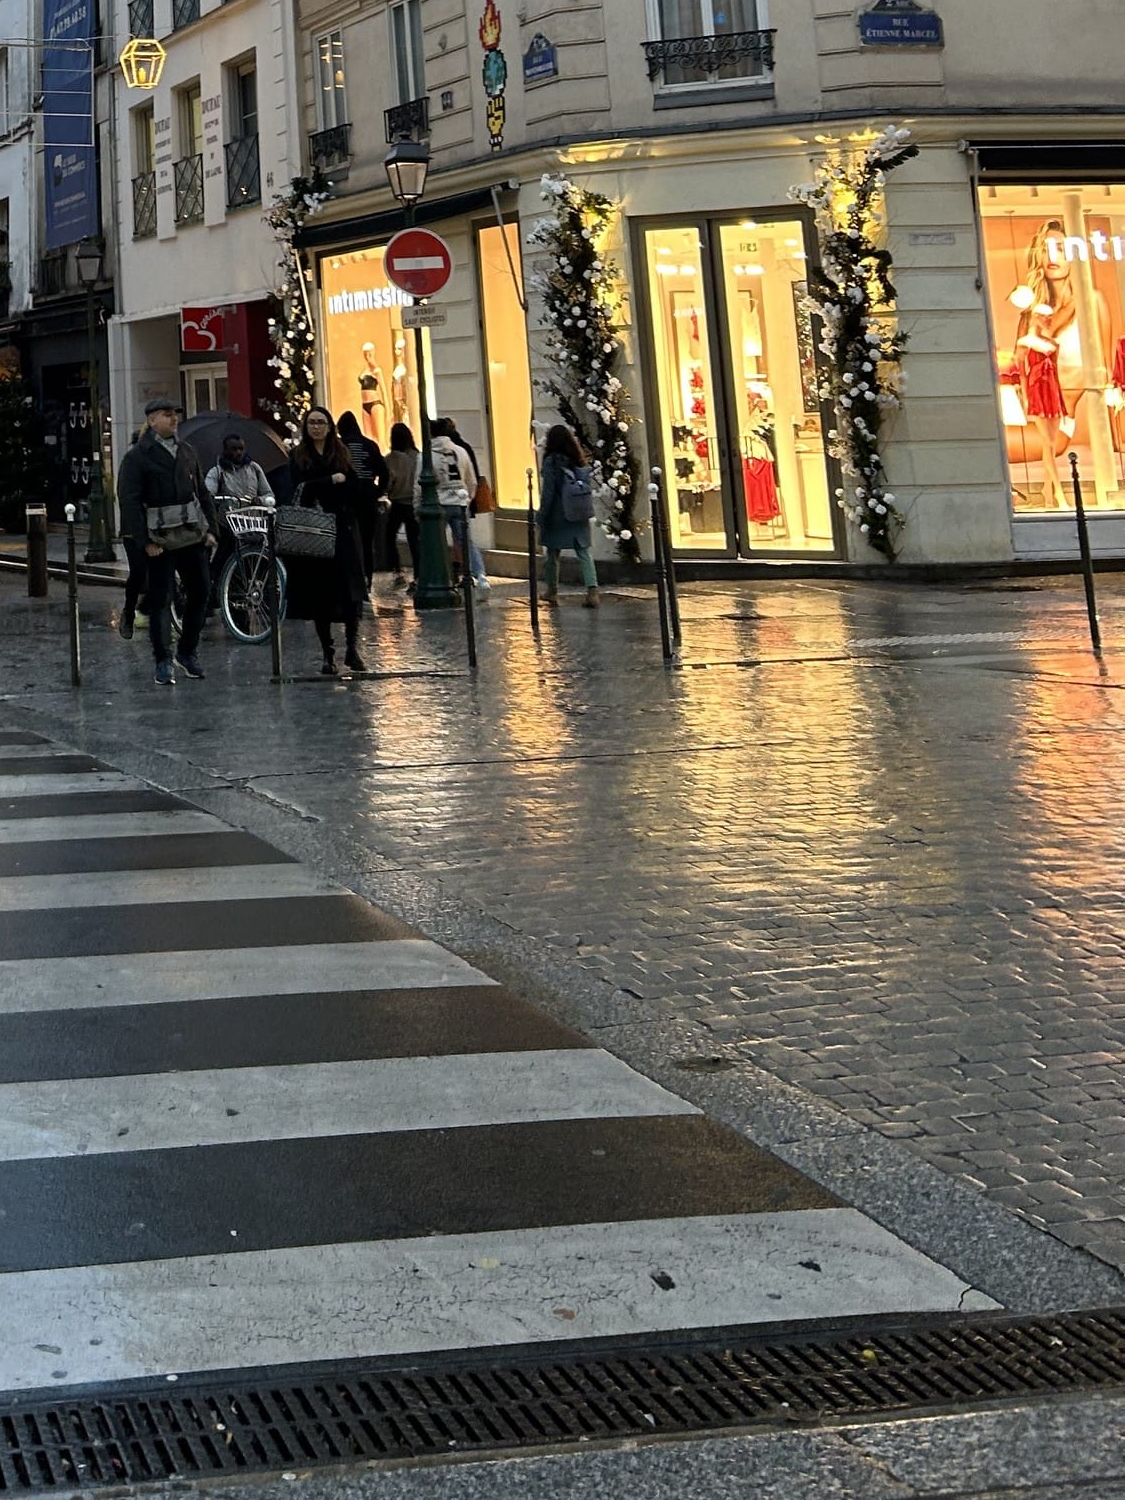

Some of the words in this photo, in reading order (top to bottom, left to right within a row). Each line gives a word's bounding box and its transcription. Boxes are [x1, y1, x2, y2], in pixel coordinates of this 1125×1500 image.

[892, 18, 909, 27] RUE
[903, 29, 938, 38] MARCEL
[328, 285, 414, 315] intimissim
